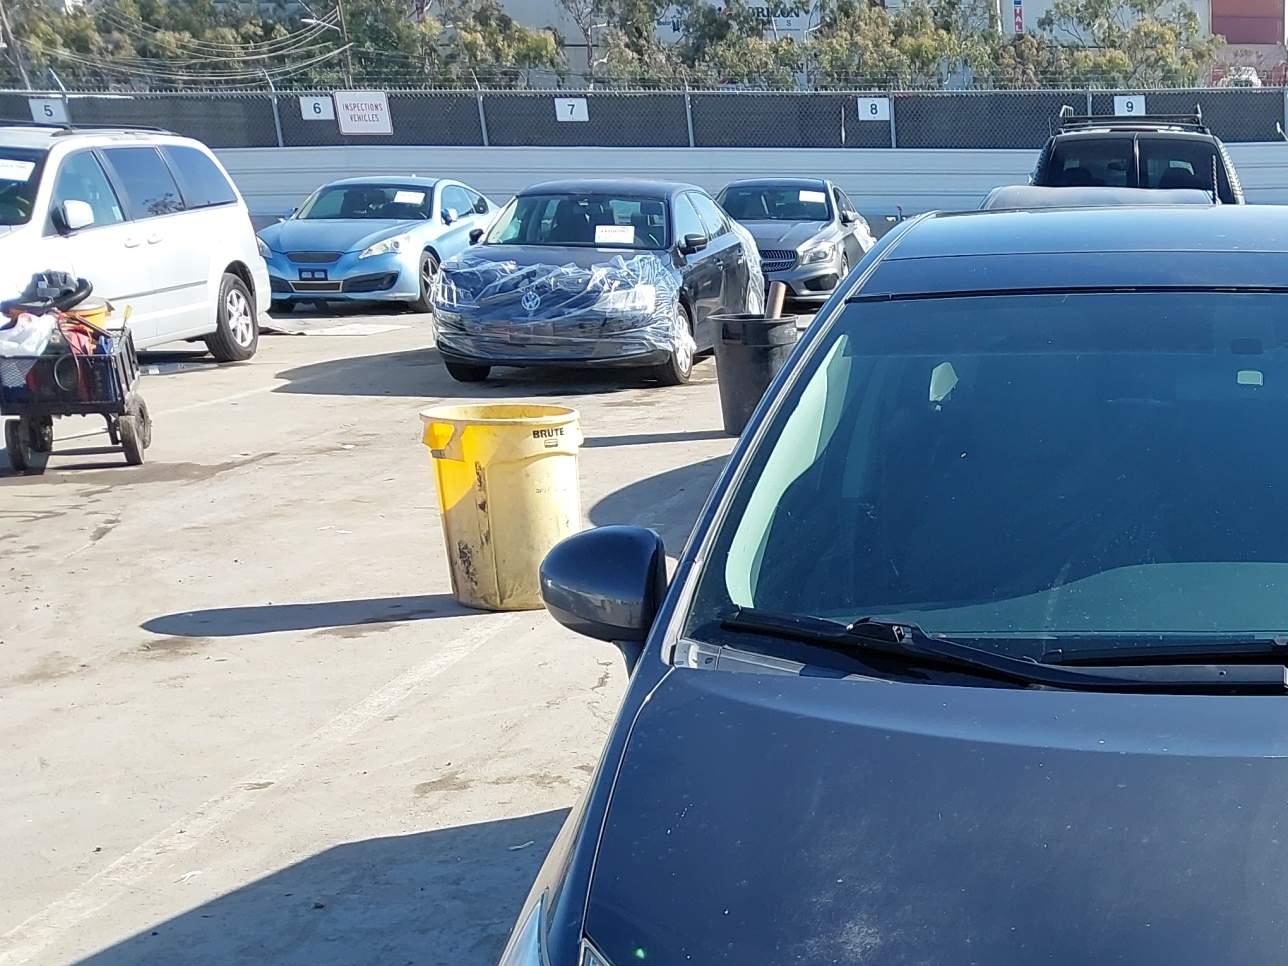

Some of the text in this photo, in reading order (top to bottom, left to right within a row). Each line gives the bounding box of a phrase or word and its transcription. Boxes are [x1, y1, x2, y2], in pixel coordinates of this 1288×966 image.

[43, 104, 54, 117] 5
[313, 102, 322, 114] 6
[342, 103, 384, 112] INSPECTIONS
[567, 104, 576, 115] 7
[870, 103, 879, 115] 8
[1126, 100, 1134, 113] 9
[349, 113, 380, 122] VEHICLES
[532, 427, 565, 439] BRUTE
